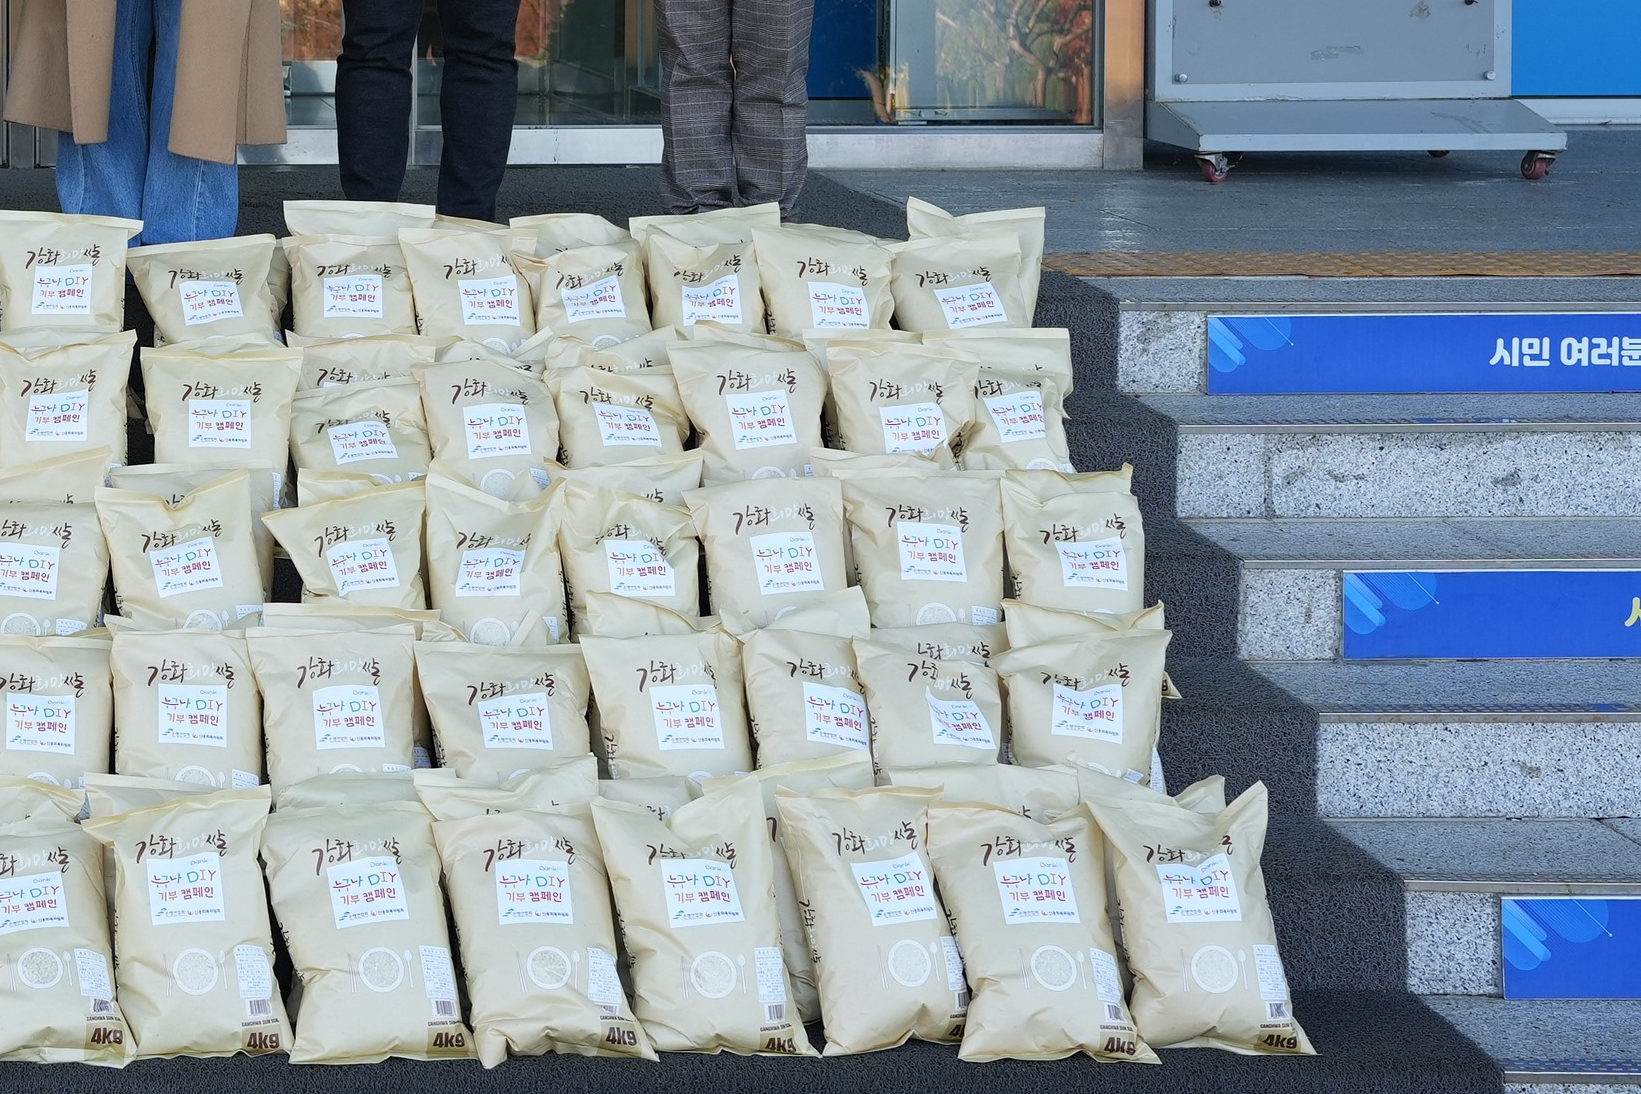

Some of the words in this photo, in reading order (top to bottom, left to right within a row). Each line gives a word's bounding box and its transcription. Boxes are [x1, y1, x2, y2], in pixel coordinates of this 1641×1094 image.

[65, 276, 89, 286] DIY
[1489, 337, 1550, 366] 시민
[761, 405, 785, 416] DIY
[29, 559, 55, 570] DIY
[317, 700, 345, 715] 누구나
[350, 701, 377, 712] DIY
[344, 716, 375, 727] 캠페인
